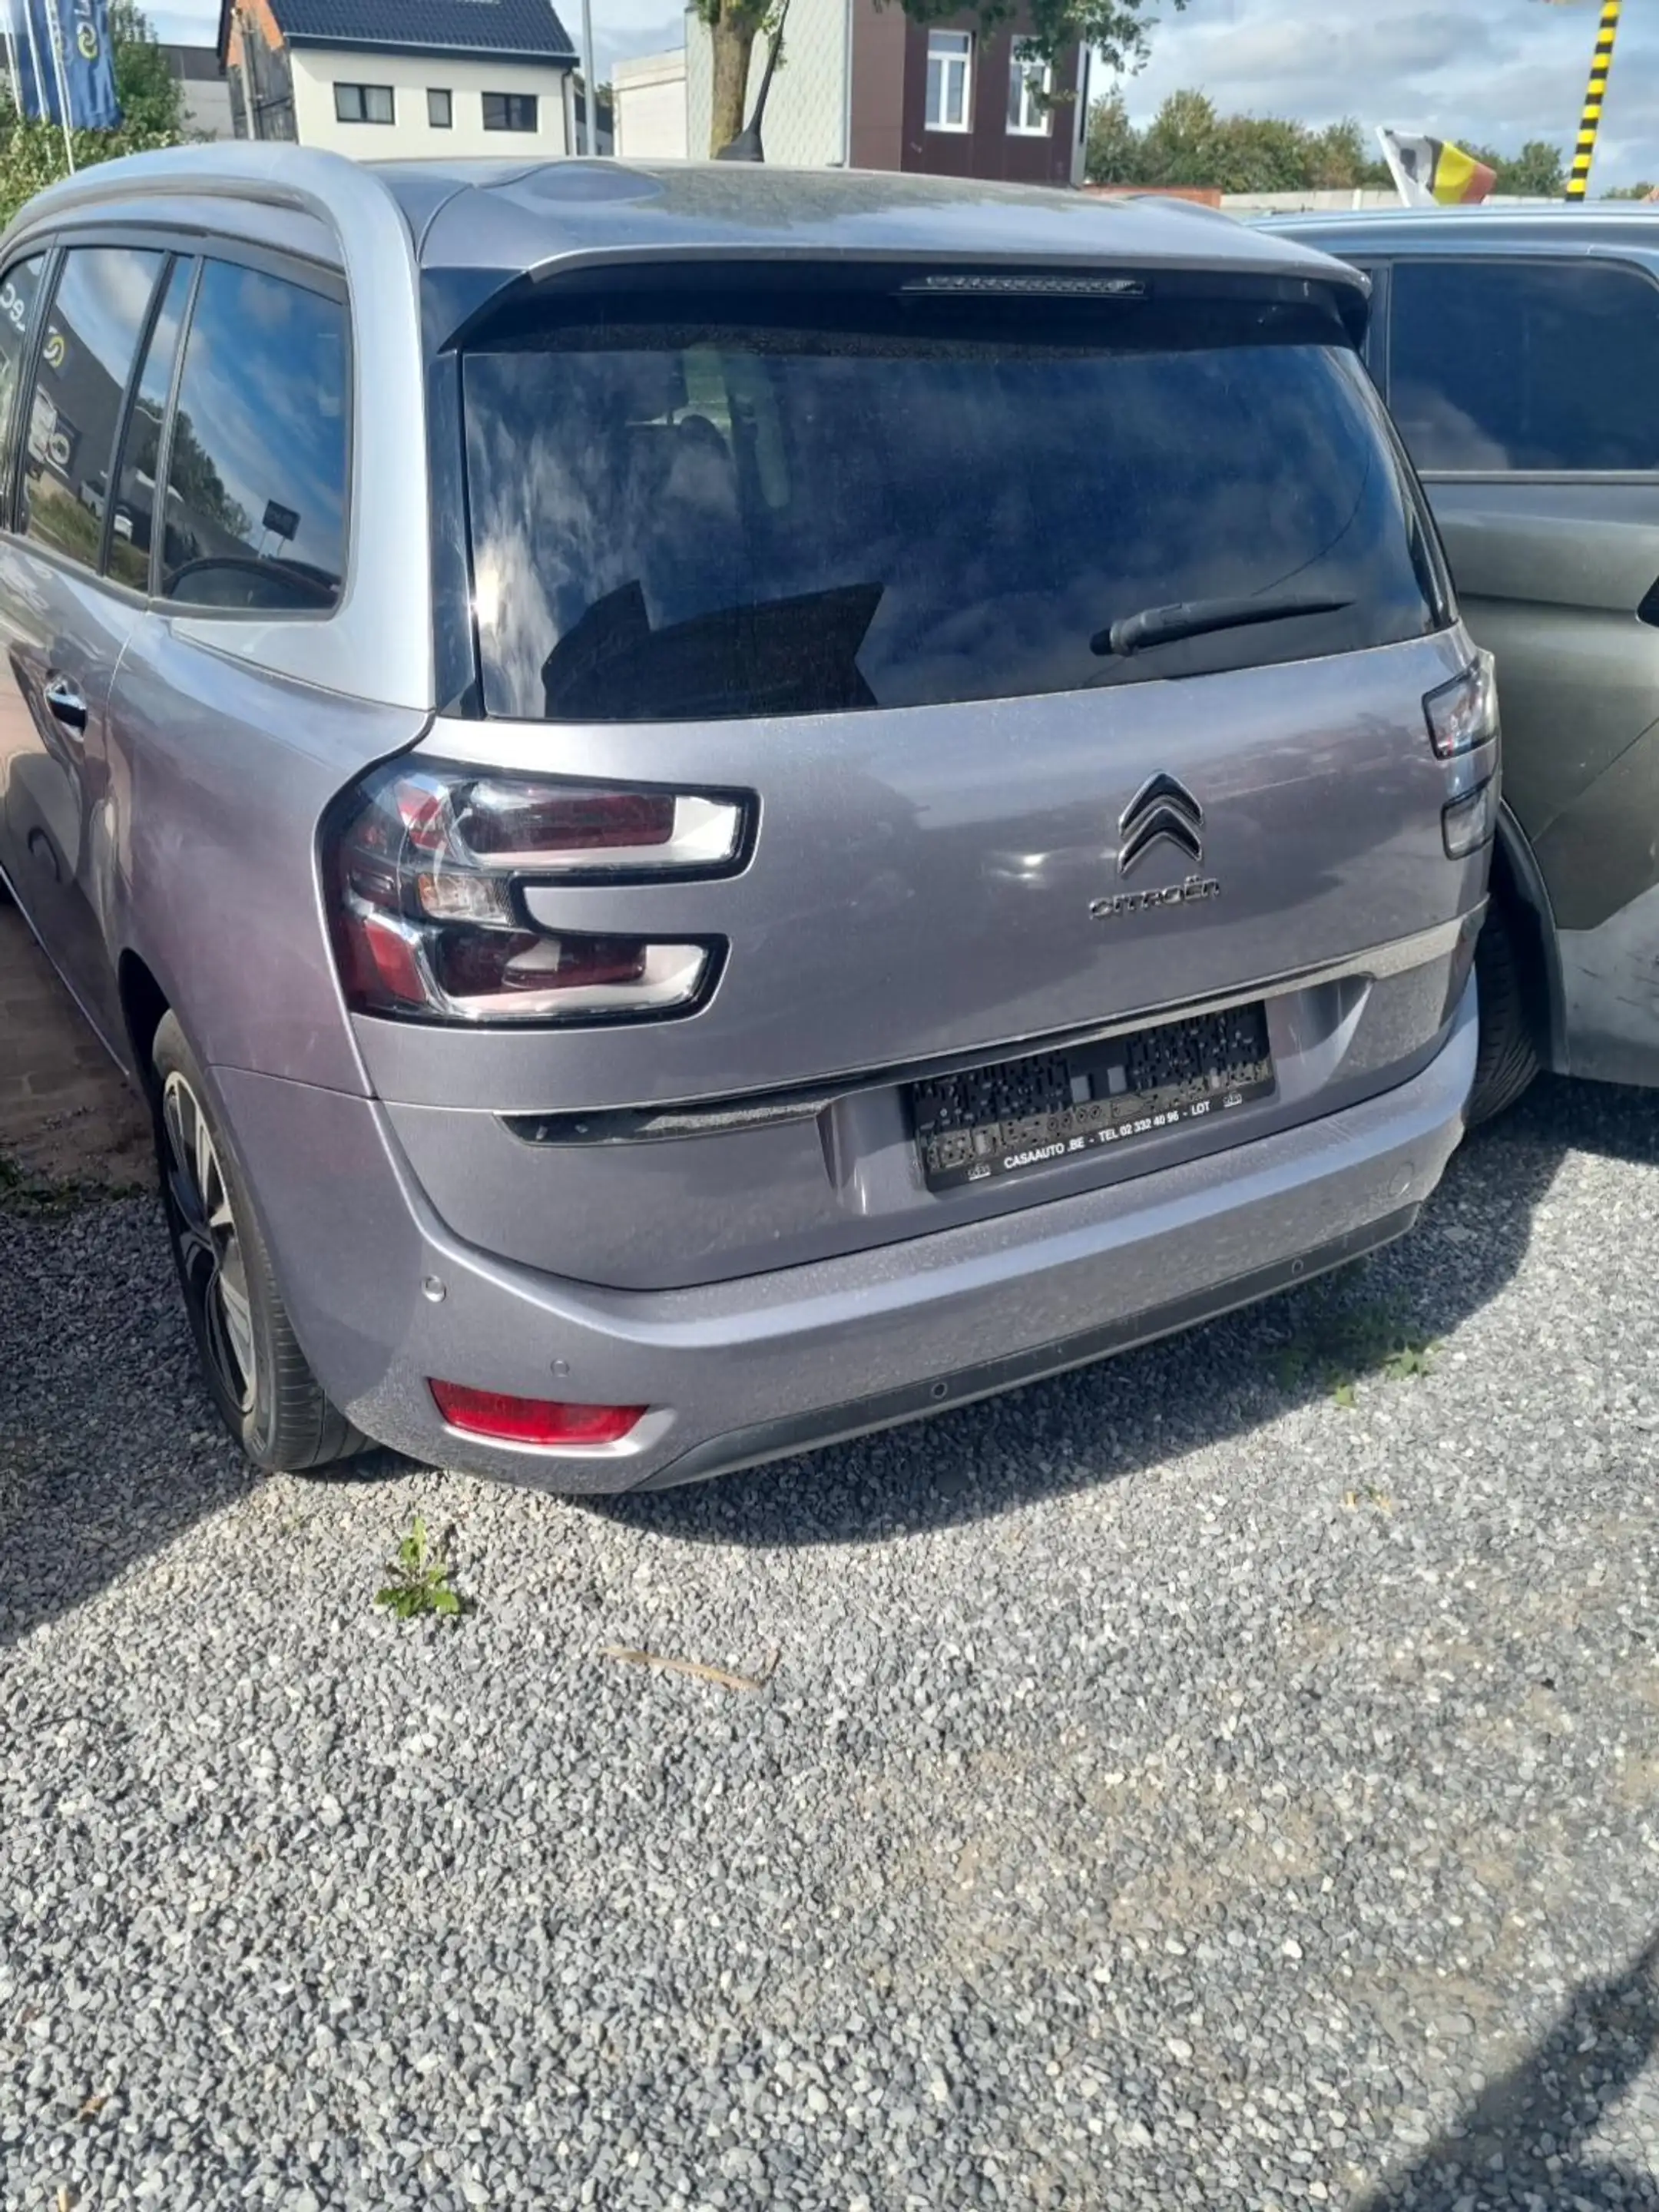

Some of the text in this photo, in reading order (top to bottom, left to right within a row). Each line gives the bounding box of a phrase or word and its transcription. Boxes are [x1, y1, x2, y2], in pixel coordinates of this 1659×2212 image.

[1004, 1142, 1065, 1168] CASAAUTO
[1098, 1128, 1118, 1143] TEL
[1120, 1124, 1134, 1137] 02
[1134, 1118, 1152, 1133] 332
[1154, 1114, 1165, 1126] 40
[1167, 1111, 1179, 1124] 96
[1191, 1101, 1210, 1116] LOT
